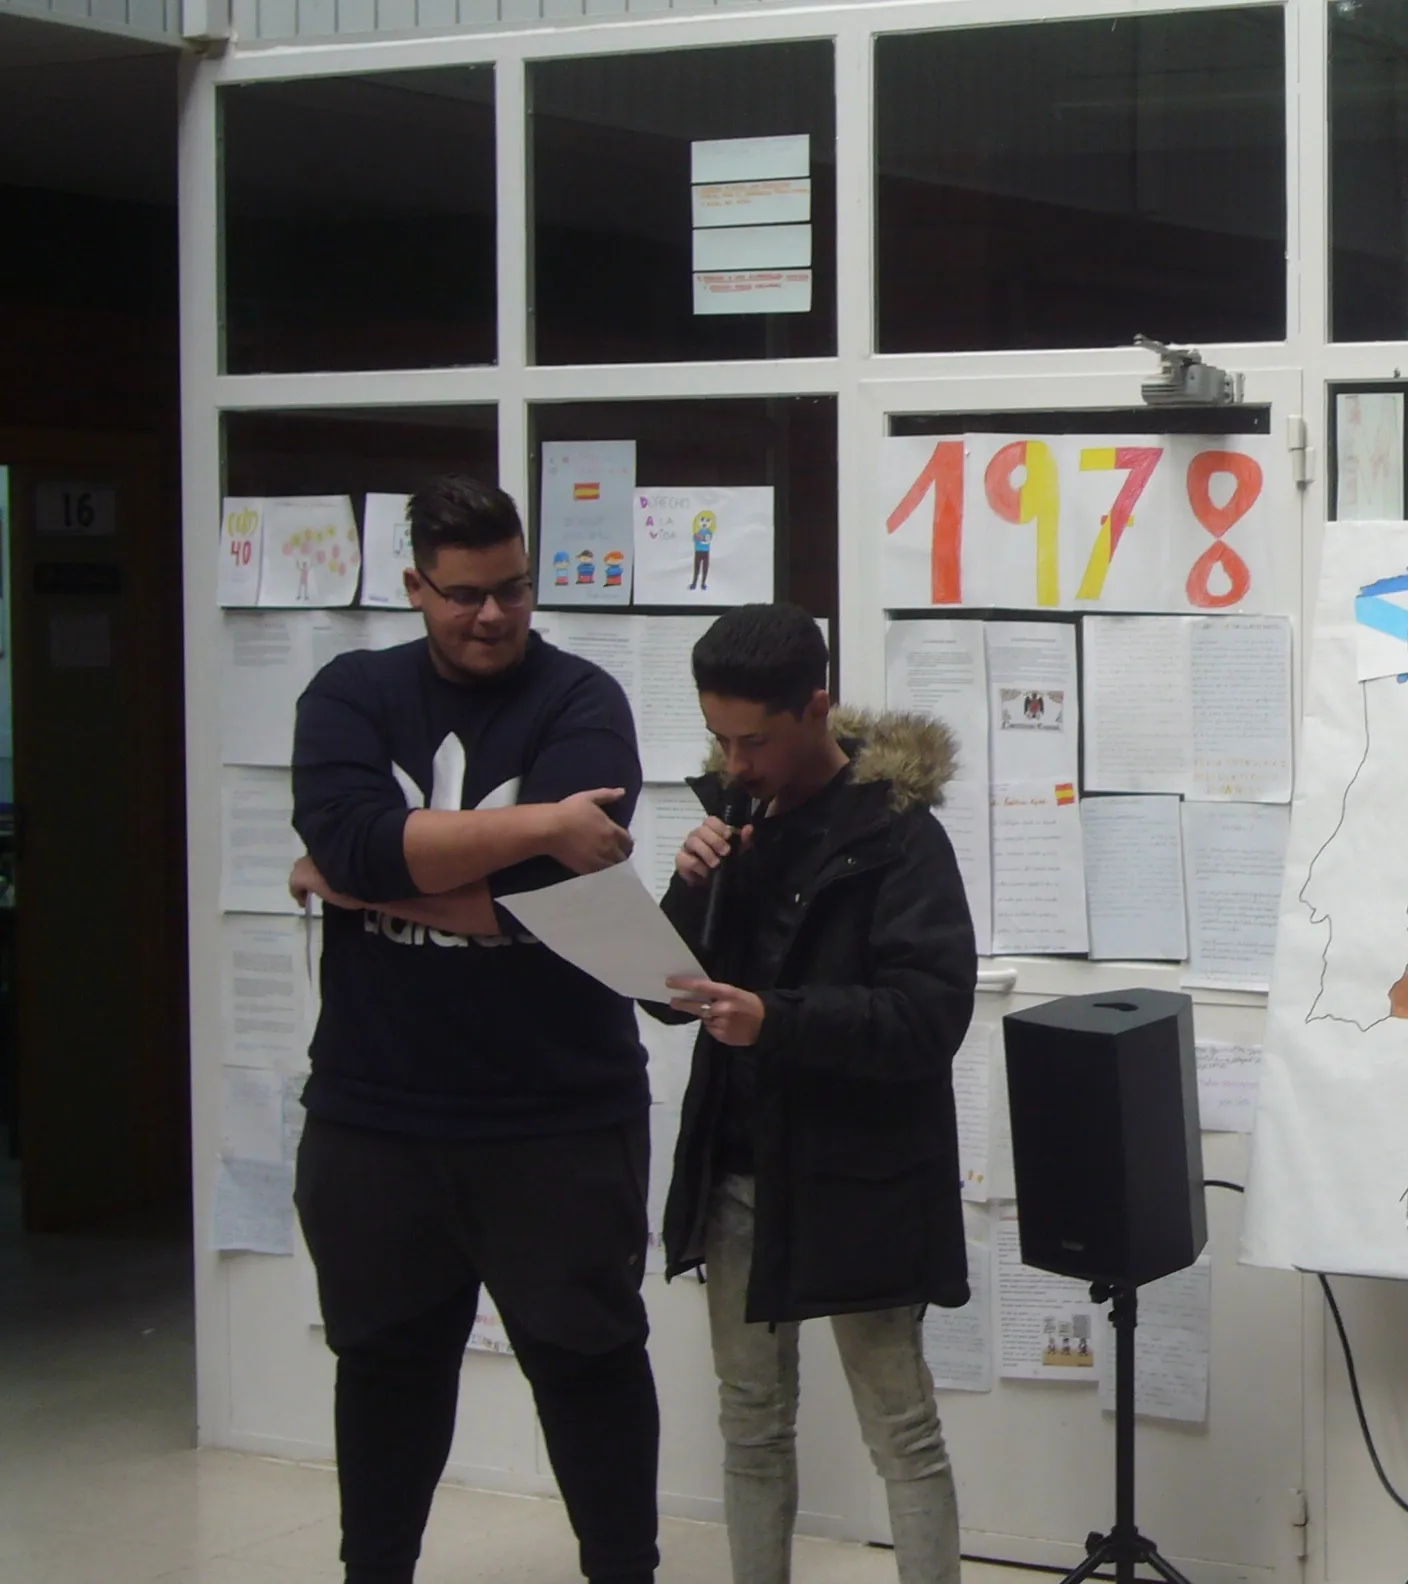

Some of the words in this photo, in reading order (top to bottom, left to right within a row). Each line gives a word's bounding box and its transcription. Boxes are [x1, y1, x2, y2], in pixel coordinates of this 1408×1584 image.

[61, 492, 96, 528] 16
[886, 440, 1263, 608] 1978
[230, 540, 252, 568] 40
